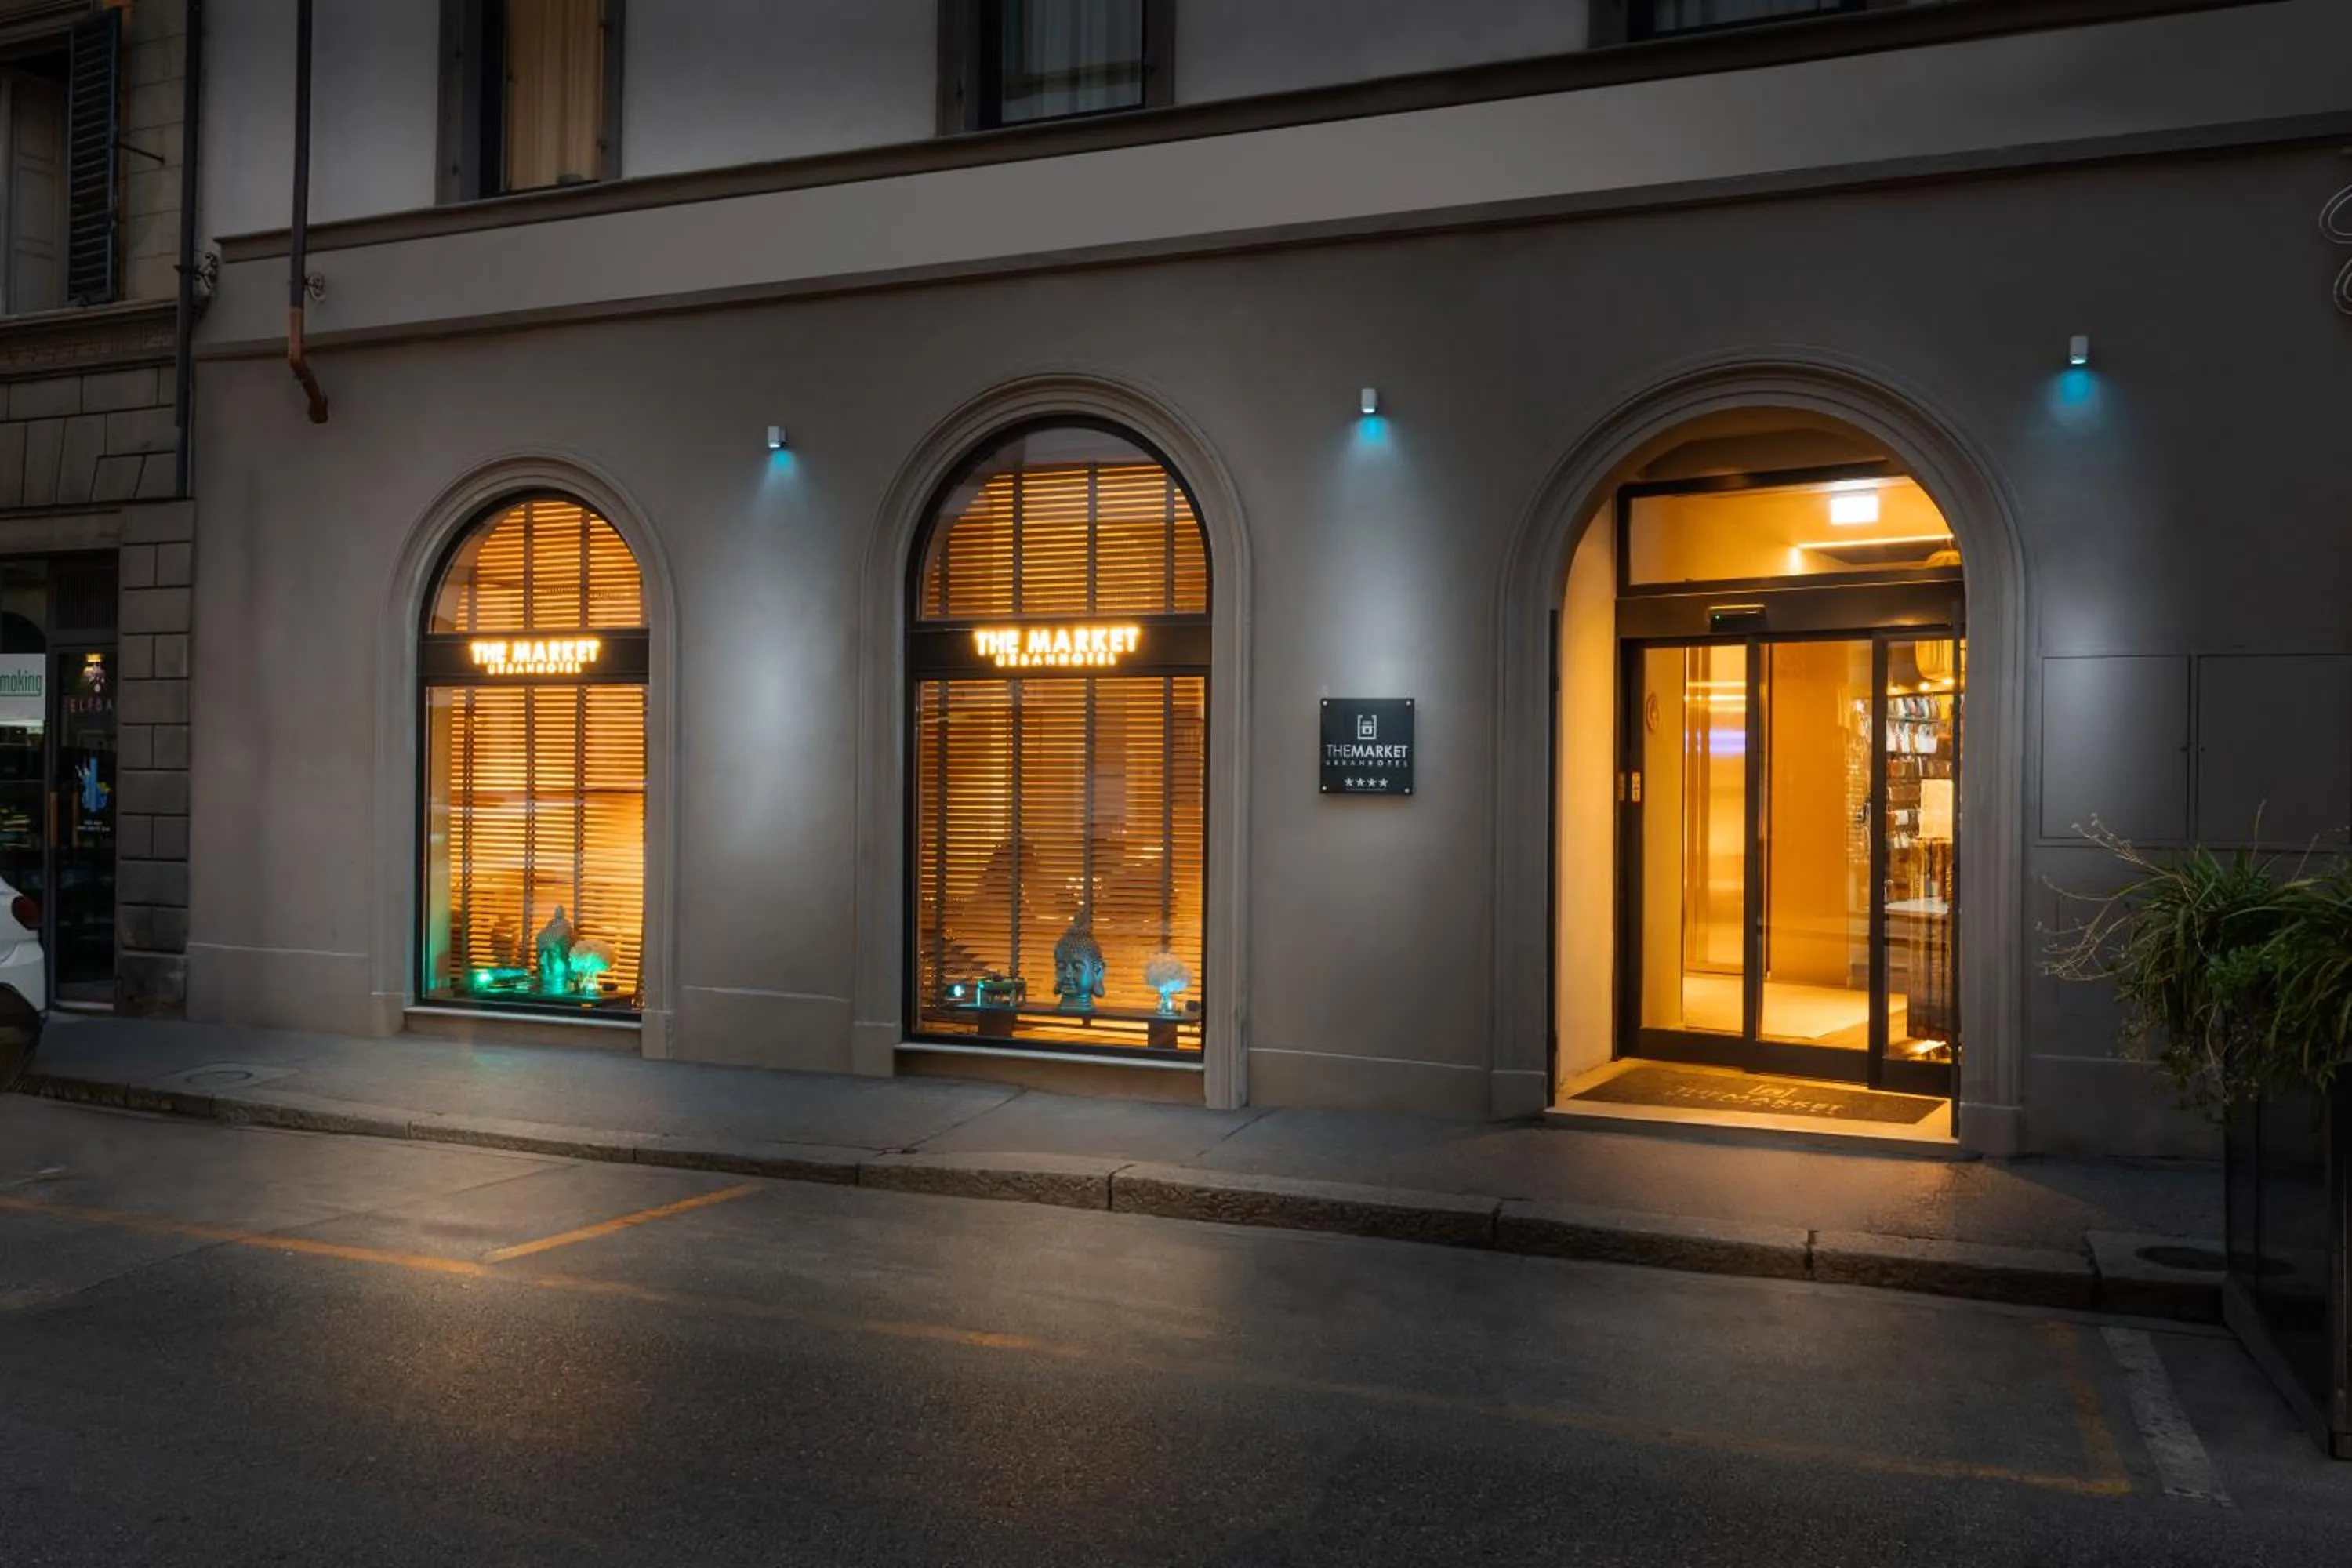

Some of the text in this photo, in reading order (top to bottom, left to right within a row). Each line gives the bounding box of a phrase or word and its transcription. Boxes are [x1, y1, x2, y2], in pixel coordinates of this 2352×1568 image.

[471, 639, 600, 664] THE MARKET
[974, 626, 1139, 655] THE MARKET
